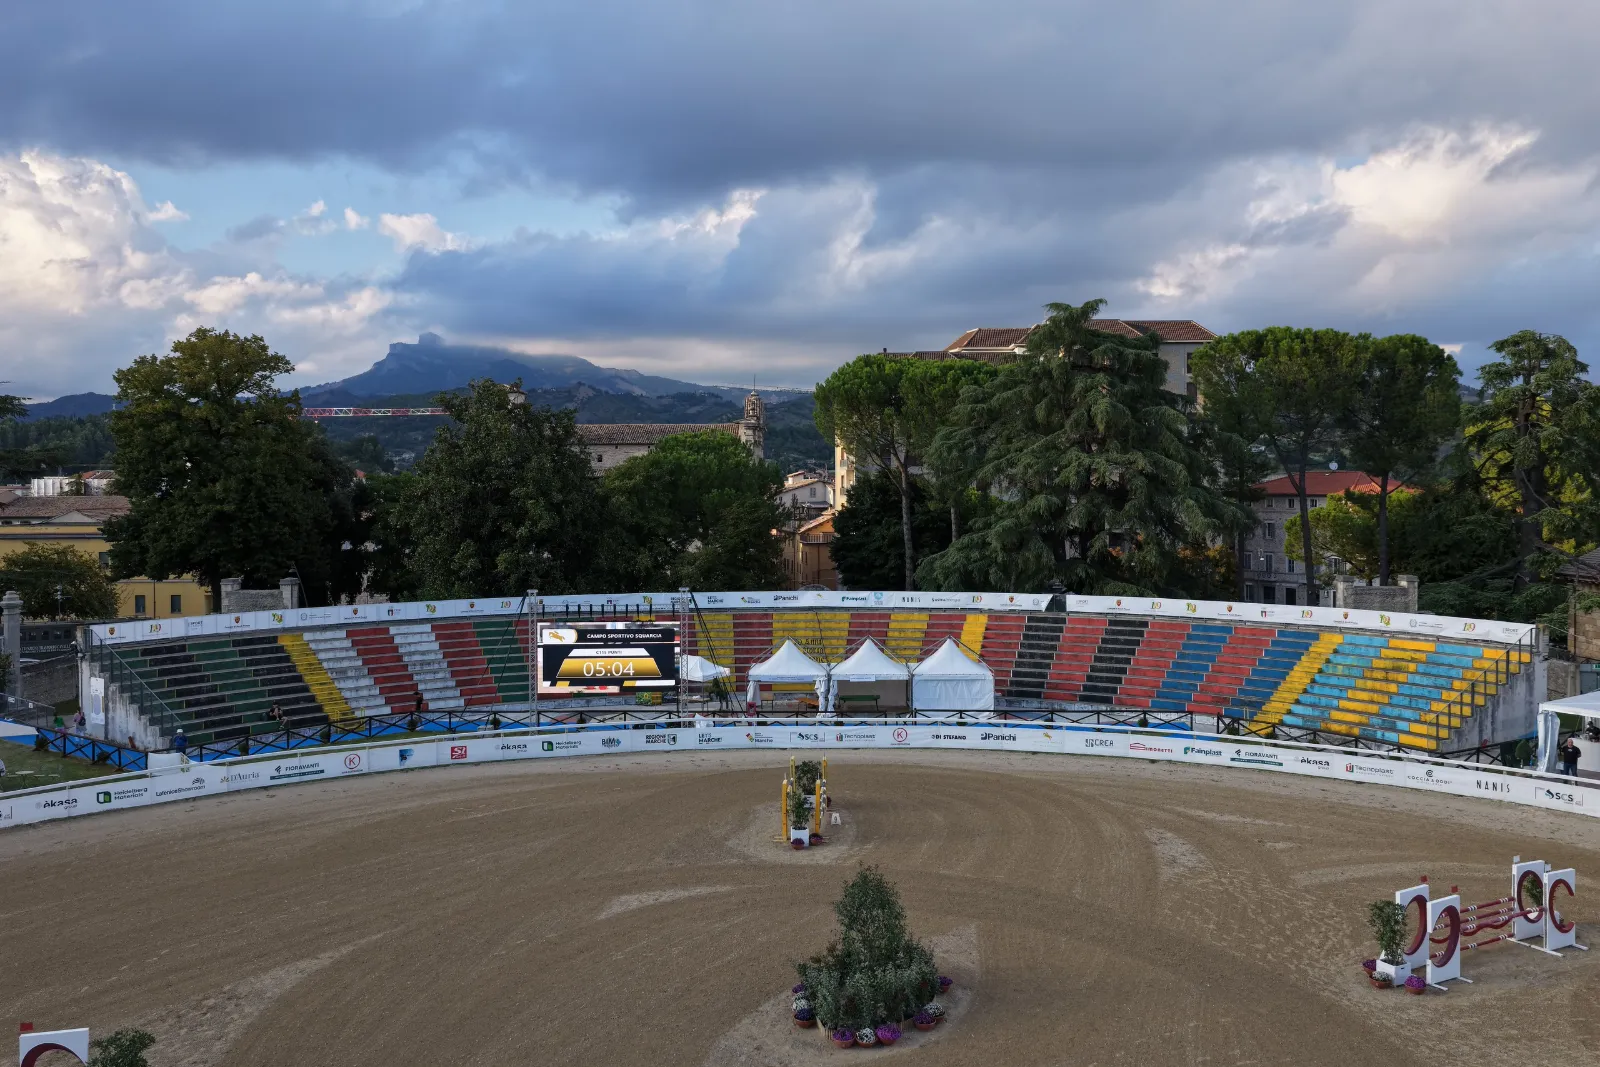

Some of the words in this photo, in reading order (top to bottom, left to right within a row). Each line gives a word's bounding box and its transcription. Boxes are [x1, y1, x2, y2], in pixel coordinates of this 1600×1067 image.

[583, 661, 635, 678] 05:04
[987, 732, 1017, 742] Panichi
[1094, 739, 1114, 747] CREA
[1190, 747, 1223, 757] Fainplast
[1244, 751, 1279, 760] FIORAVANTI
[285, 762, 320, 772] FIORAVANTI
[230, 772, 260, 782] D'Auria
[1476, 779, 1511, 793] NANIS
[114, 787, 148, 796] Heidelberg
[1555, 792, 1574, 802] SCS
